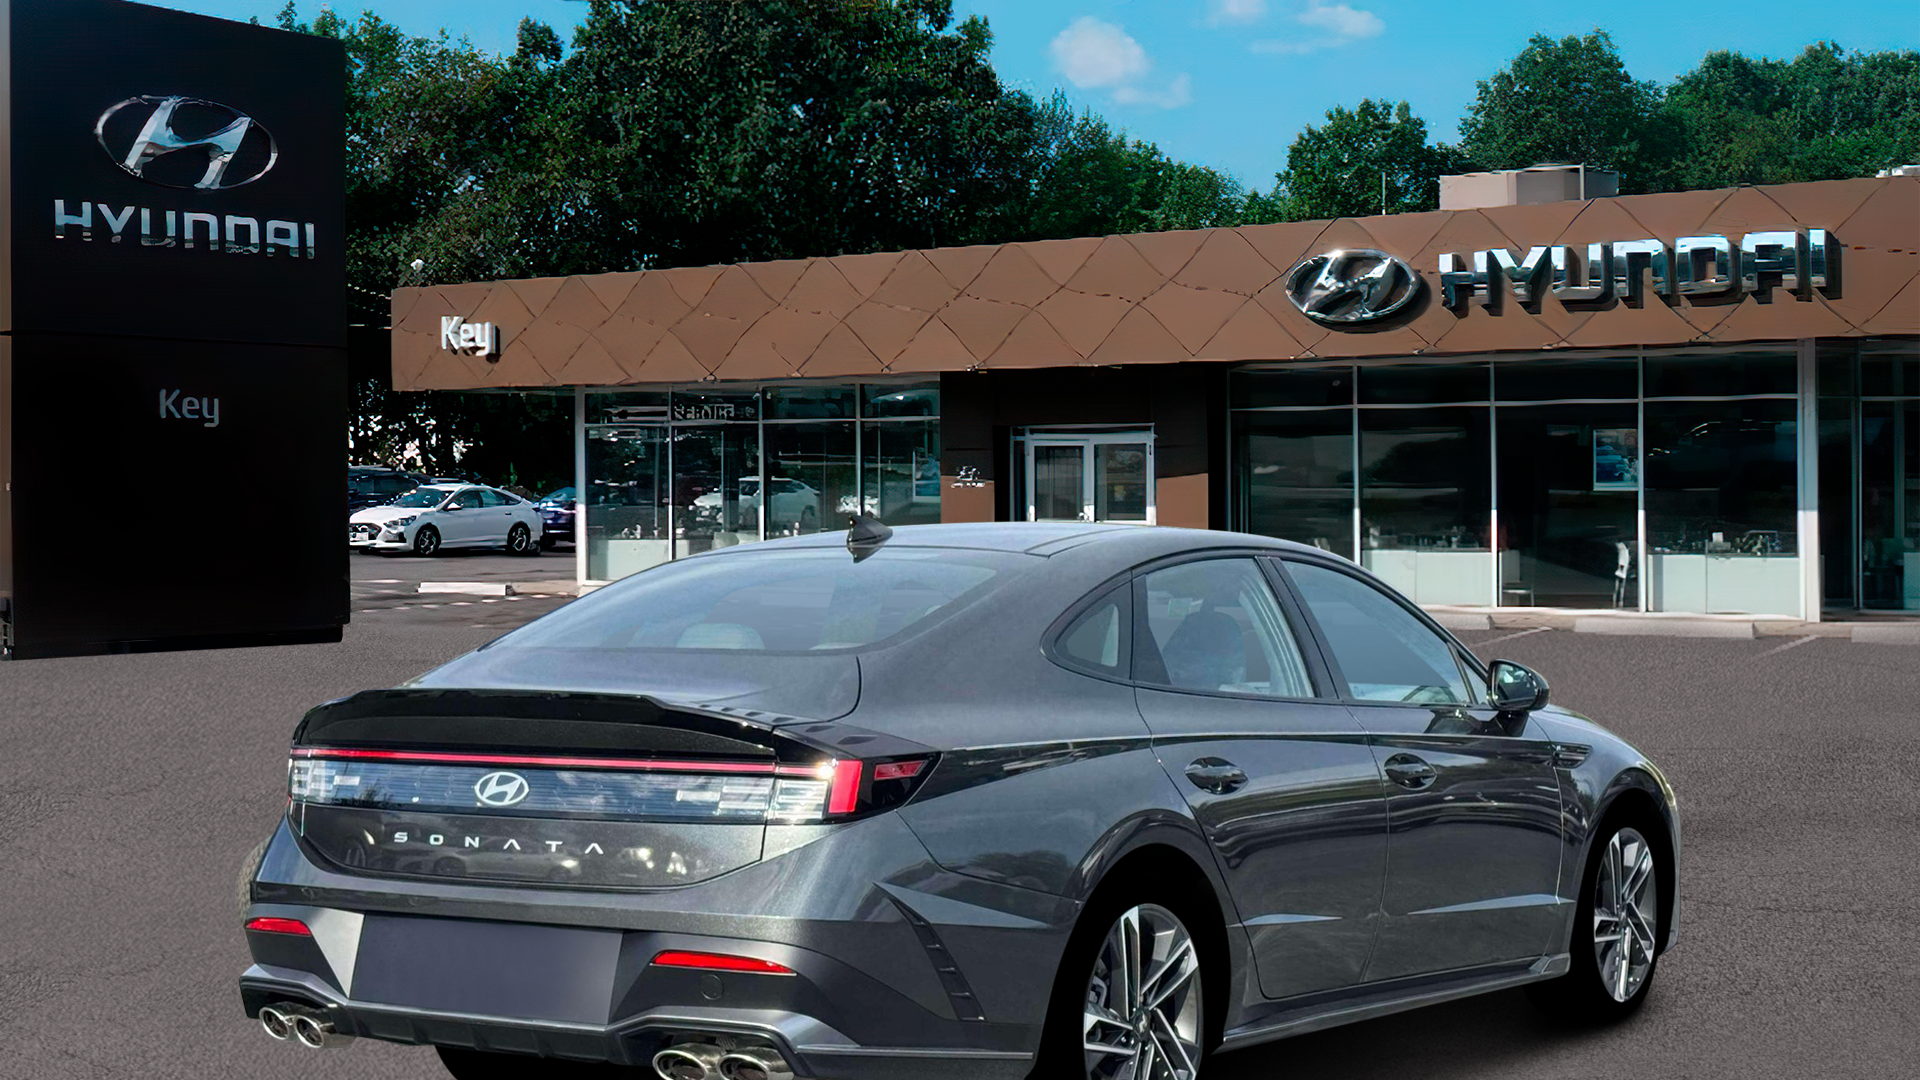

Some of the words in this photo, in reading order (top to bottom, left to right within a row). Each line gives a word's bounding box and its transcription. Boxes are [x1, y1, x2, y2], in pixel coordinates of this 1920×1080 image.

[54, 199, 315, 259] HYUNDAI
[1438, 229, 1842, 318] HYUNDAI
[441, 316, 492, 357] Key
[158, 388, 219, 427] Key
[394, 831, 604, 855] SONATA
